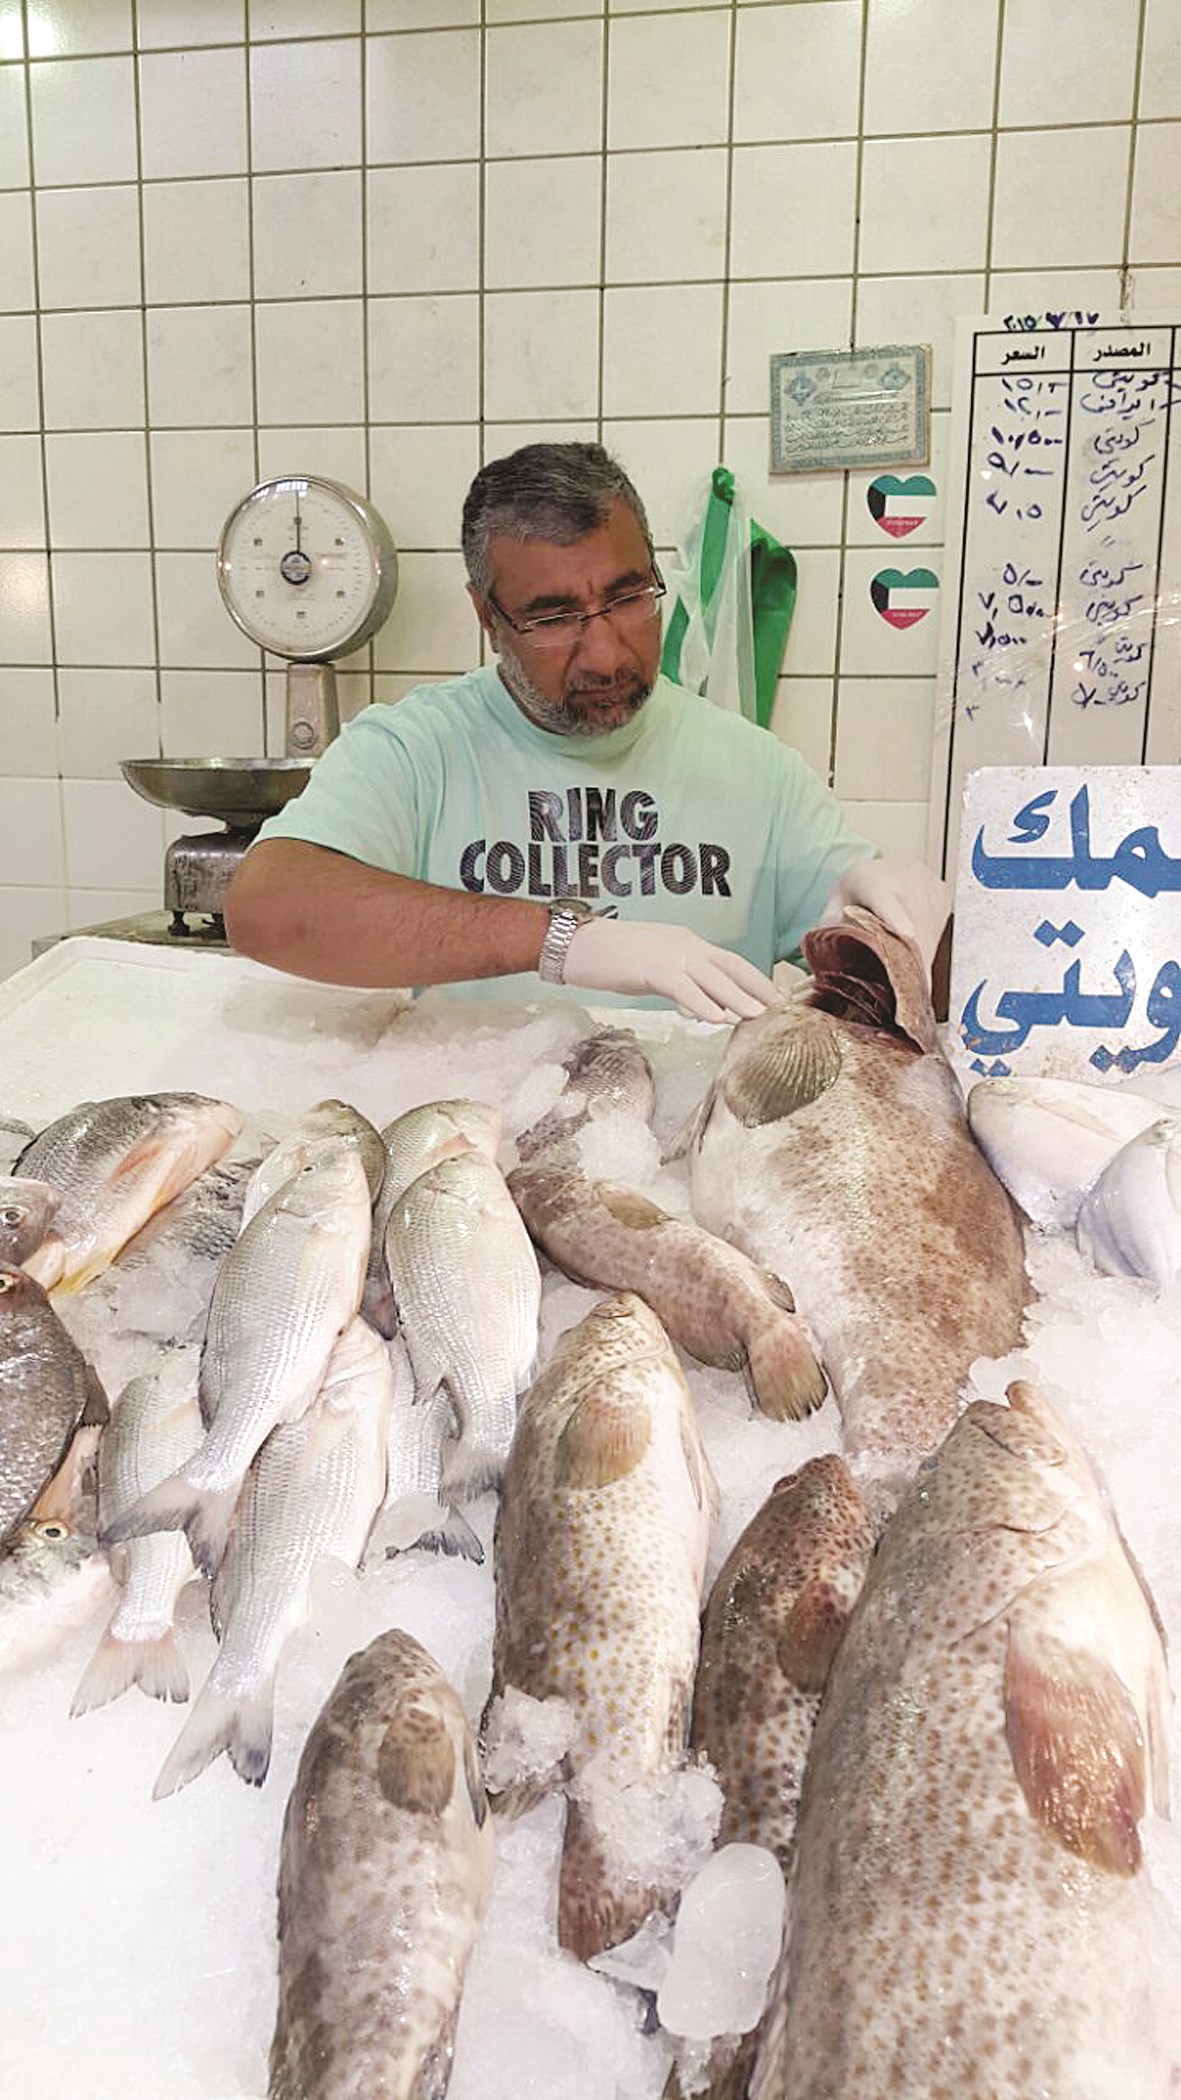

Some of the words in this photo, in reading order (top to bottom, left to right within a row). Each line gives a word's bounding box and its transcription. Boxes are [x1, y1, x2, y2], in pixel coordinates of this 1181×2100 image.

[1001, 346, 1045, 365] السعر
[1092, 341, 1151, 362] المصدر
[528, 787, 659, 843] RING
[971, 783, 1181, 900] مك
[459, 839, 732, 898] COLLECTOR
[960, 918, 1181, 1078] ويتي
